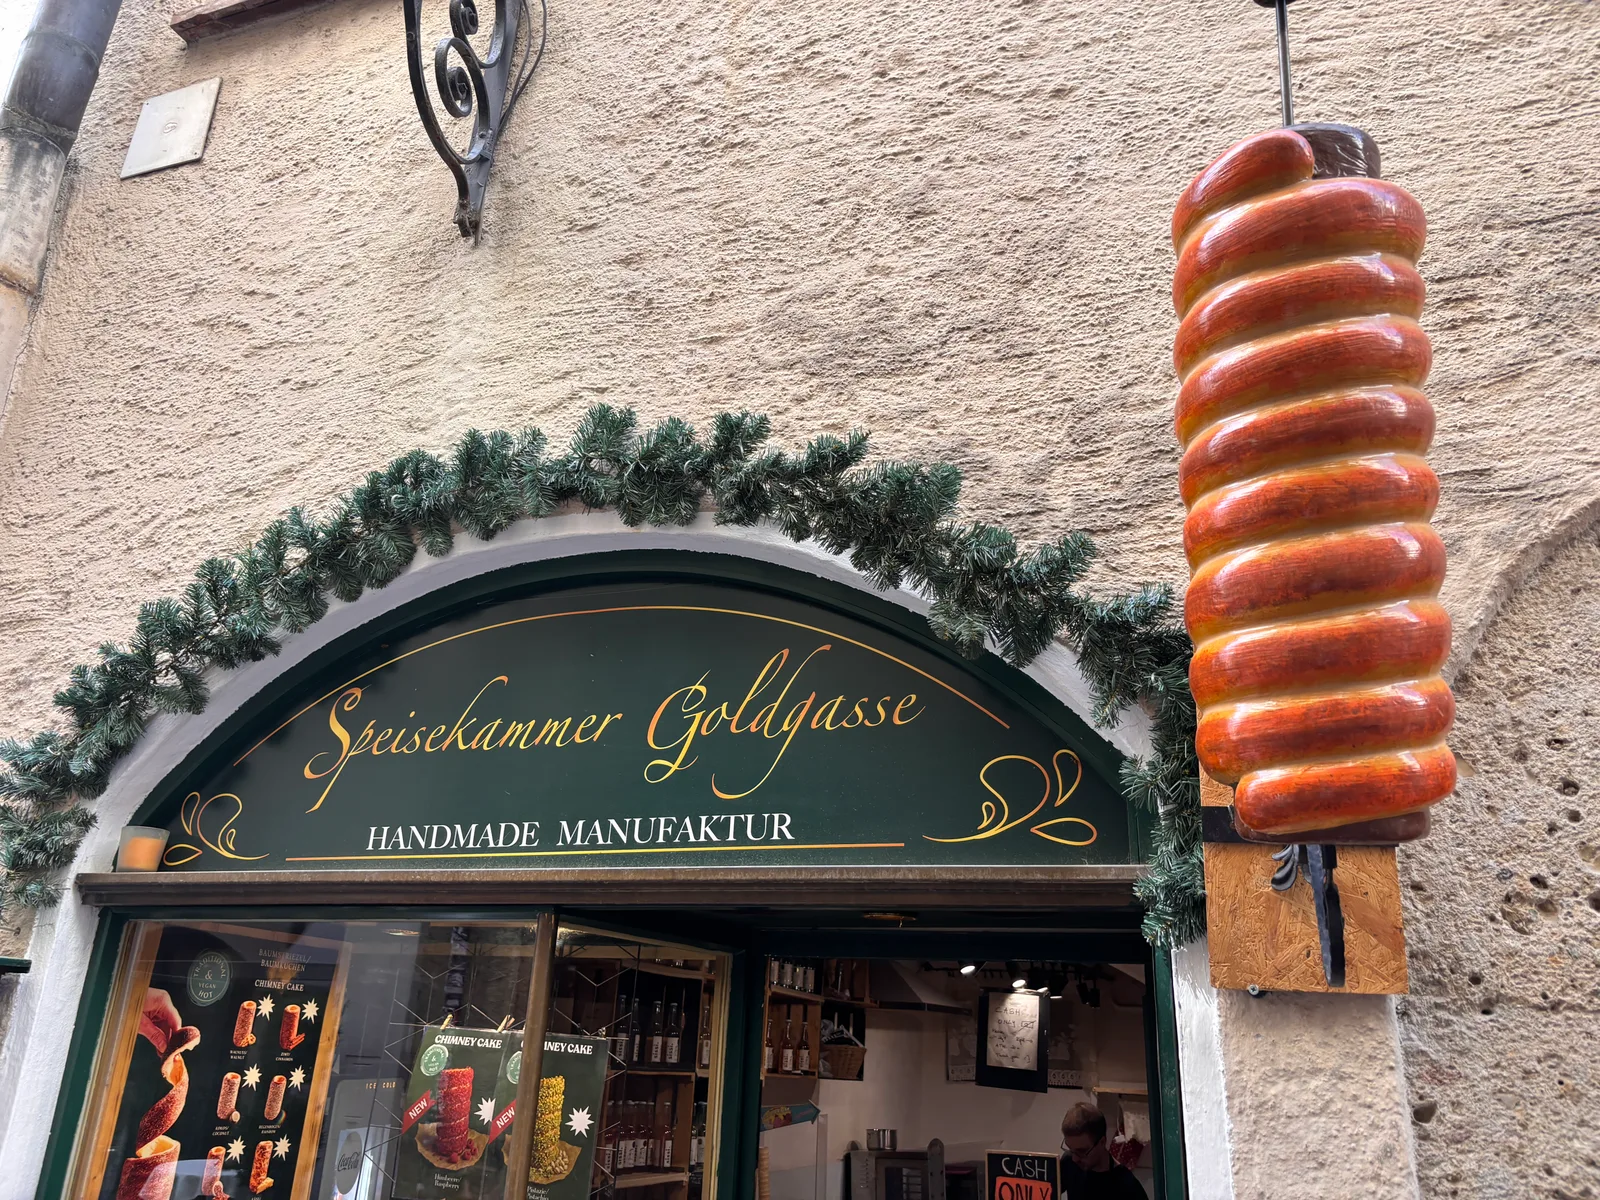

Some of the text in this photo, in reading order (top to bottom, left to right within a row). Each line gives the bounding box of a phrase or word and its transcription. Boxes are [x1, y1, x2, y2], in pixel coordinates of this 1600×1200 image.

[304, 643, 927, 813] Speisekammer Goldgasse
[366, 812, 795, 851] HANDMADE MANUFAKTUR
[193, 955, 227, 979] TRADITIONAL
[204, 970, 213, 980] &
[254, 979, 305, 992] CHIMNEY CAKE
[199, 990, 213, 999] HOT
[434, 1034, 503, 1049] CHIMNEY CAKE
[566, 1043, 593, 1055] CAKE
[366, 1081, 397, 1090] ICE COLD
[408, 1098, 428, 1120] NEW
[495, 1107, 516, 1129] NEW
[1001, 1157, 1048, 1181] CASH
[434, 1180, 460, 1191] Raspberry
